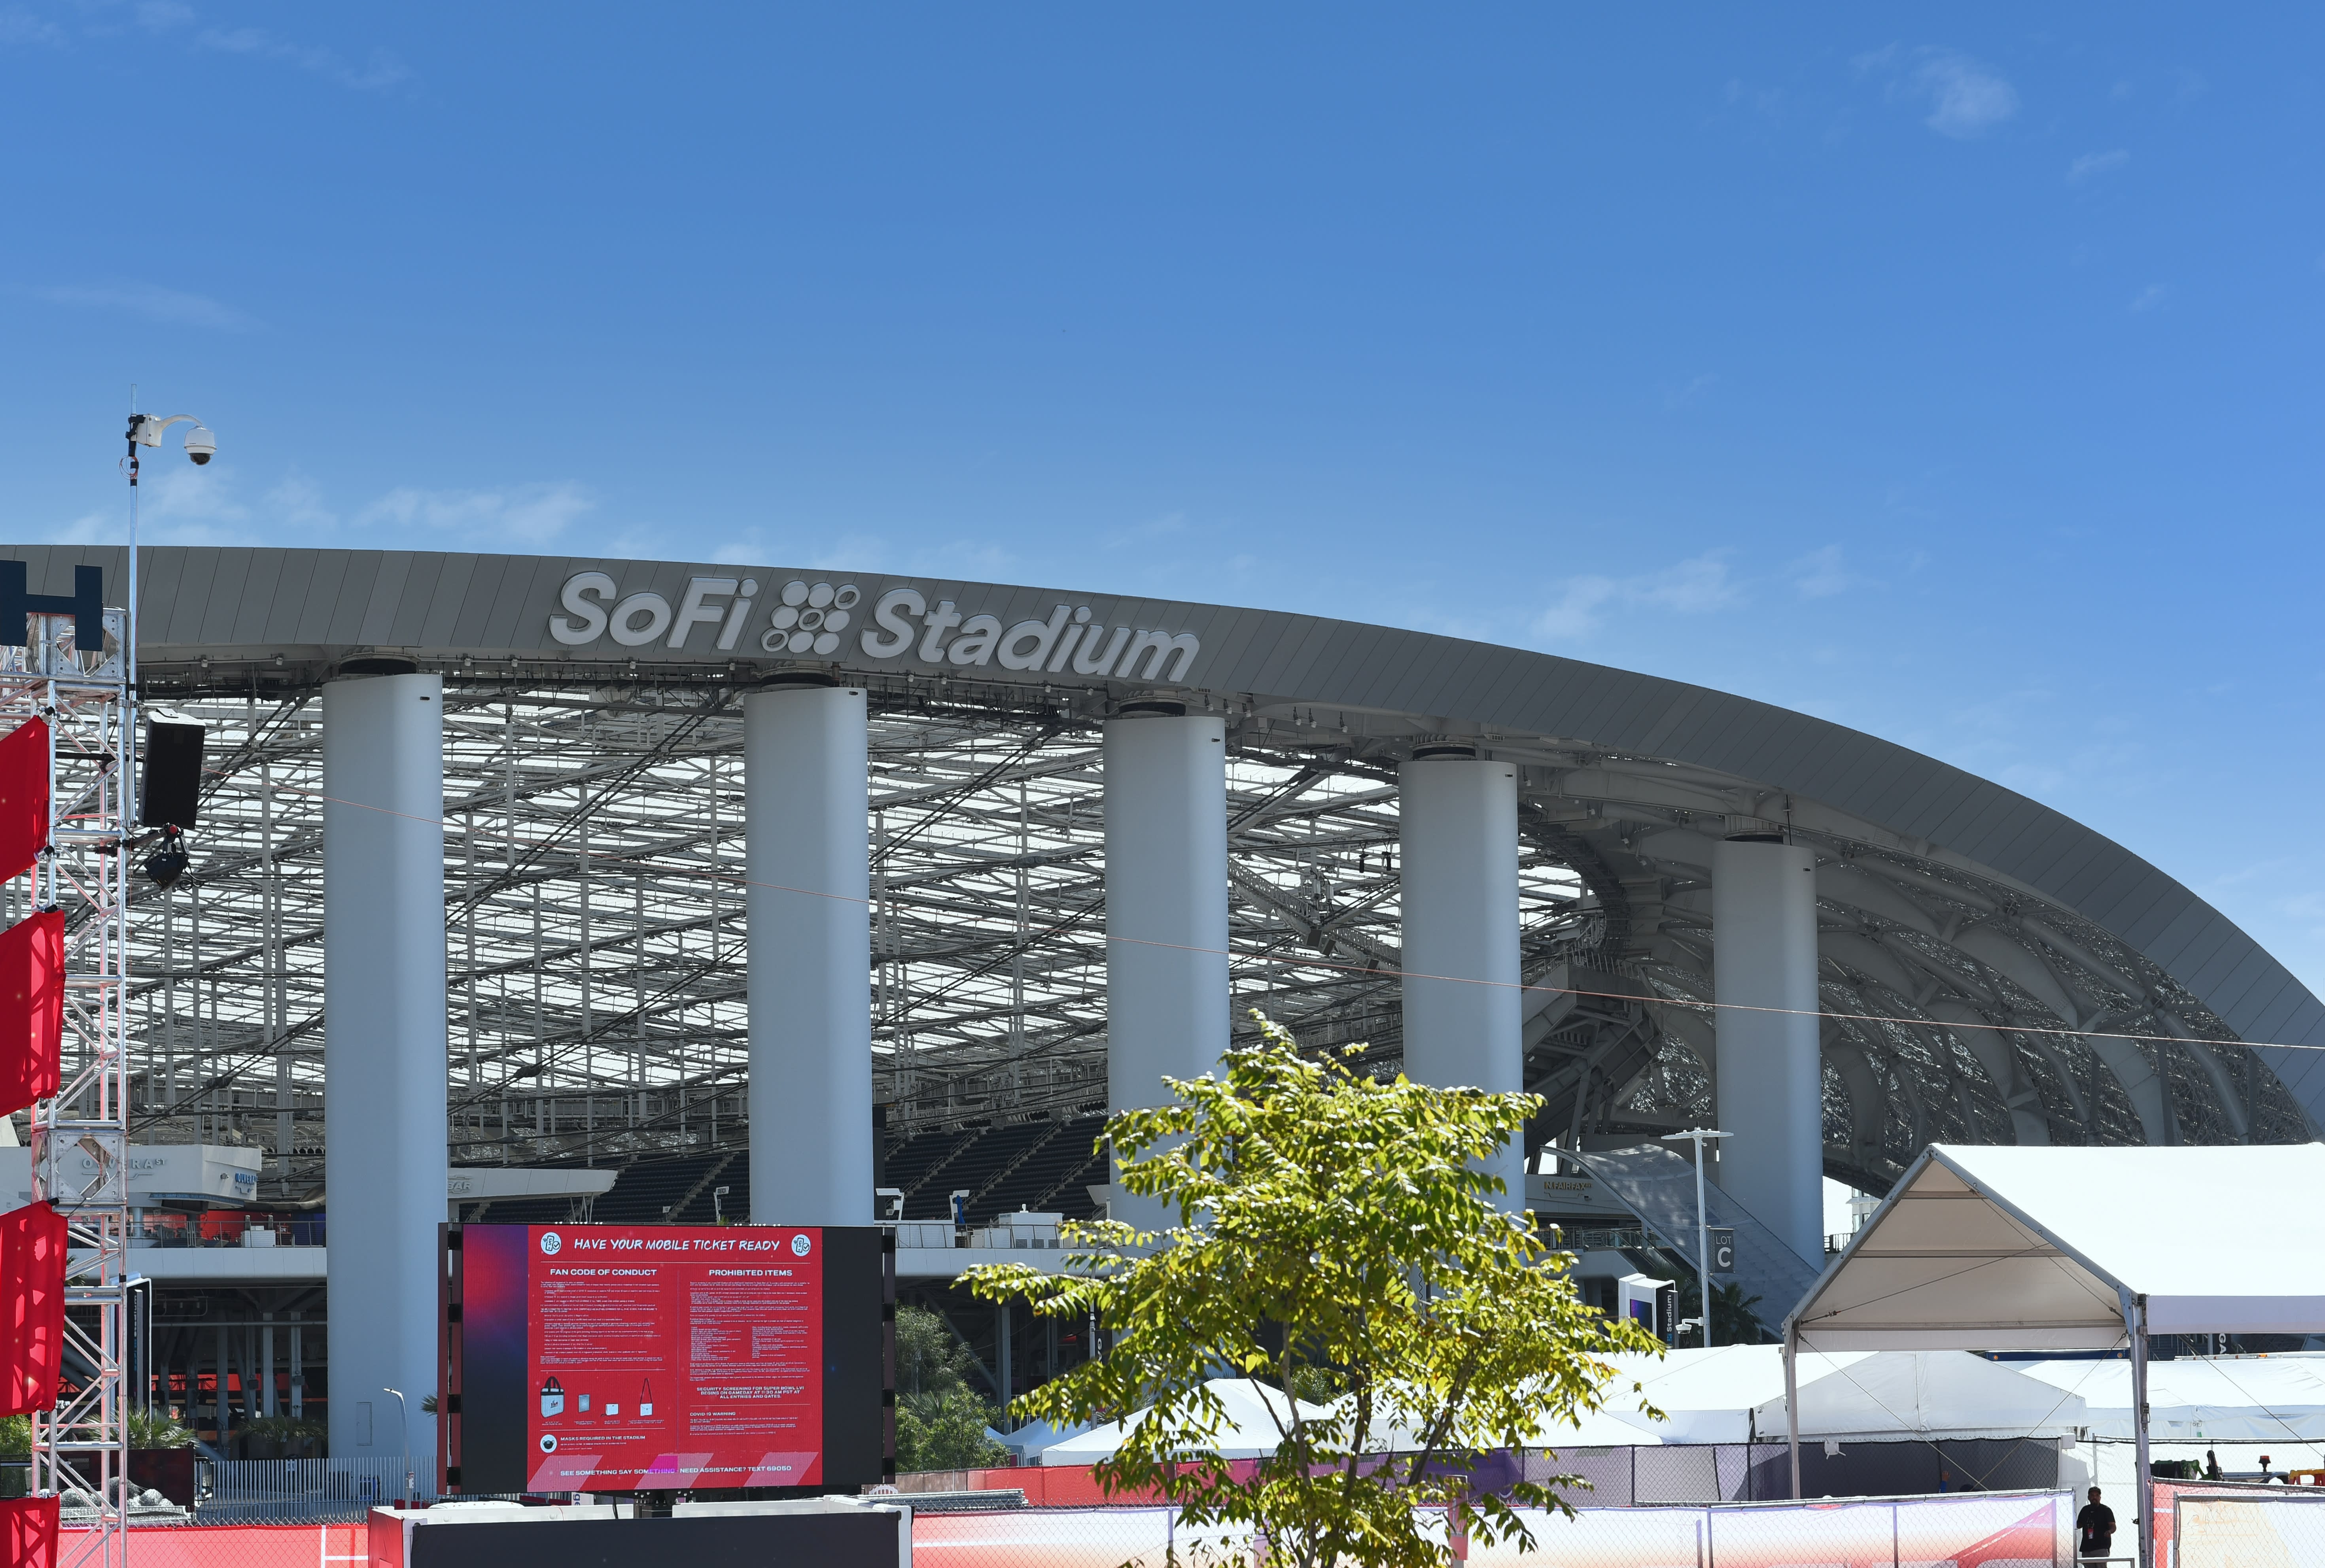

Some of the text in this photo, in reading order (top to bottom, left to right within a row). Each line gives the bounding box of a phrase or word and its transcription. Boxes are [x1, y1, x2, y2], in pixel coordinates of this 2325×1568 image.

[549, 572, 1200, 682] SoFi Stadium
[1553, 1182, 1585, 1190] FAIRFAX
[574, 1238, 780, 1251] HAVE YOUR MOBILE TICKET READY
[1716, 1236, 1732, 1245] LOT
[1717, 1247, 1731, 1268] C
